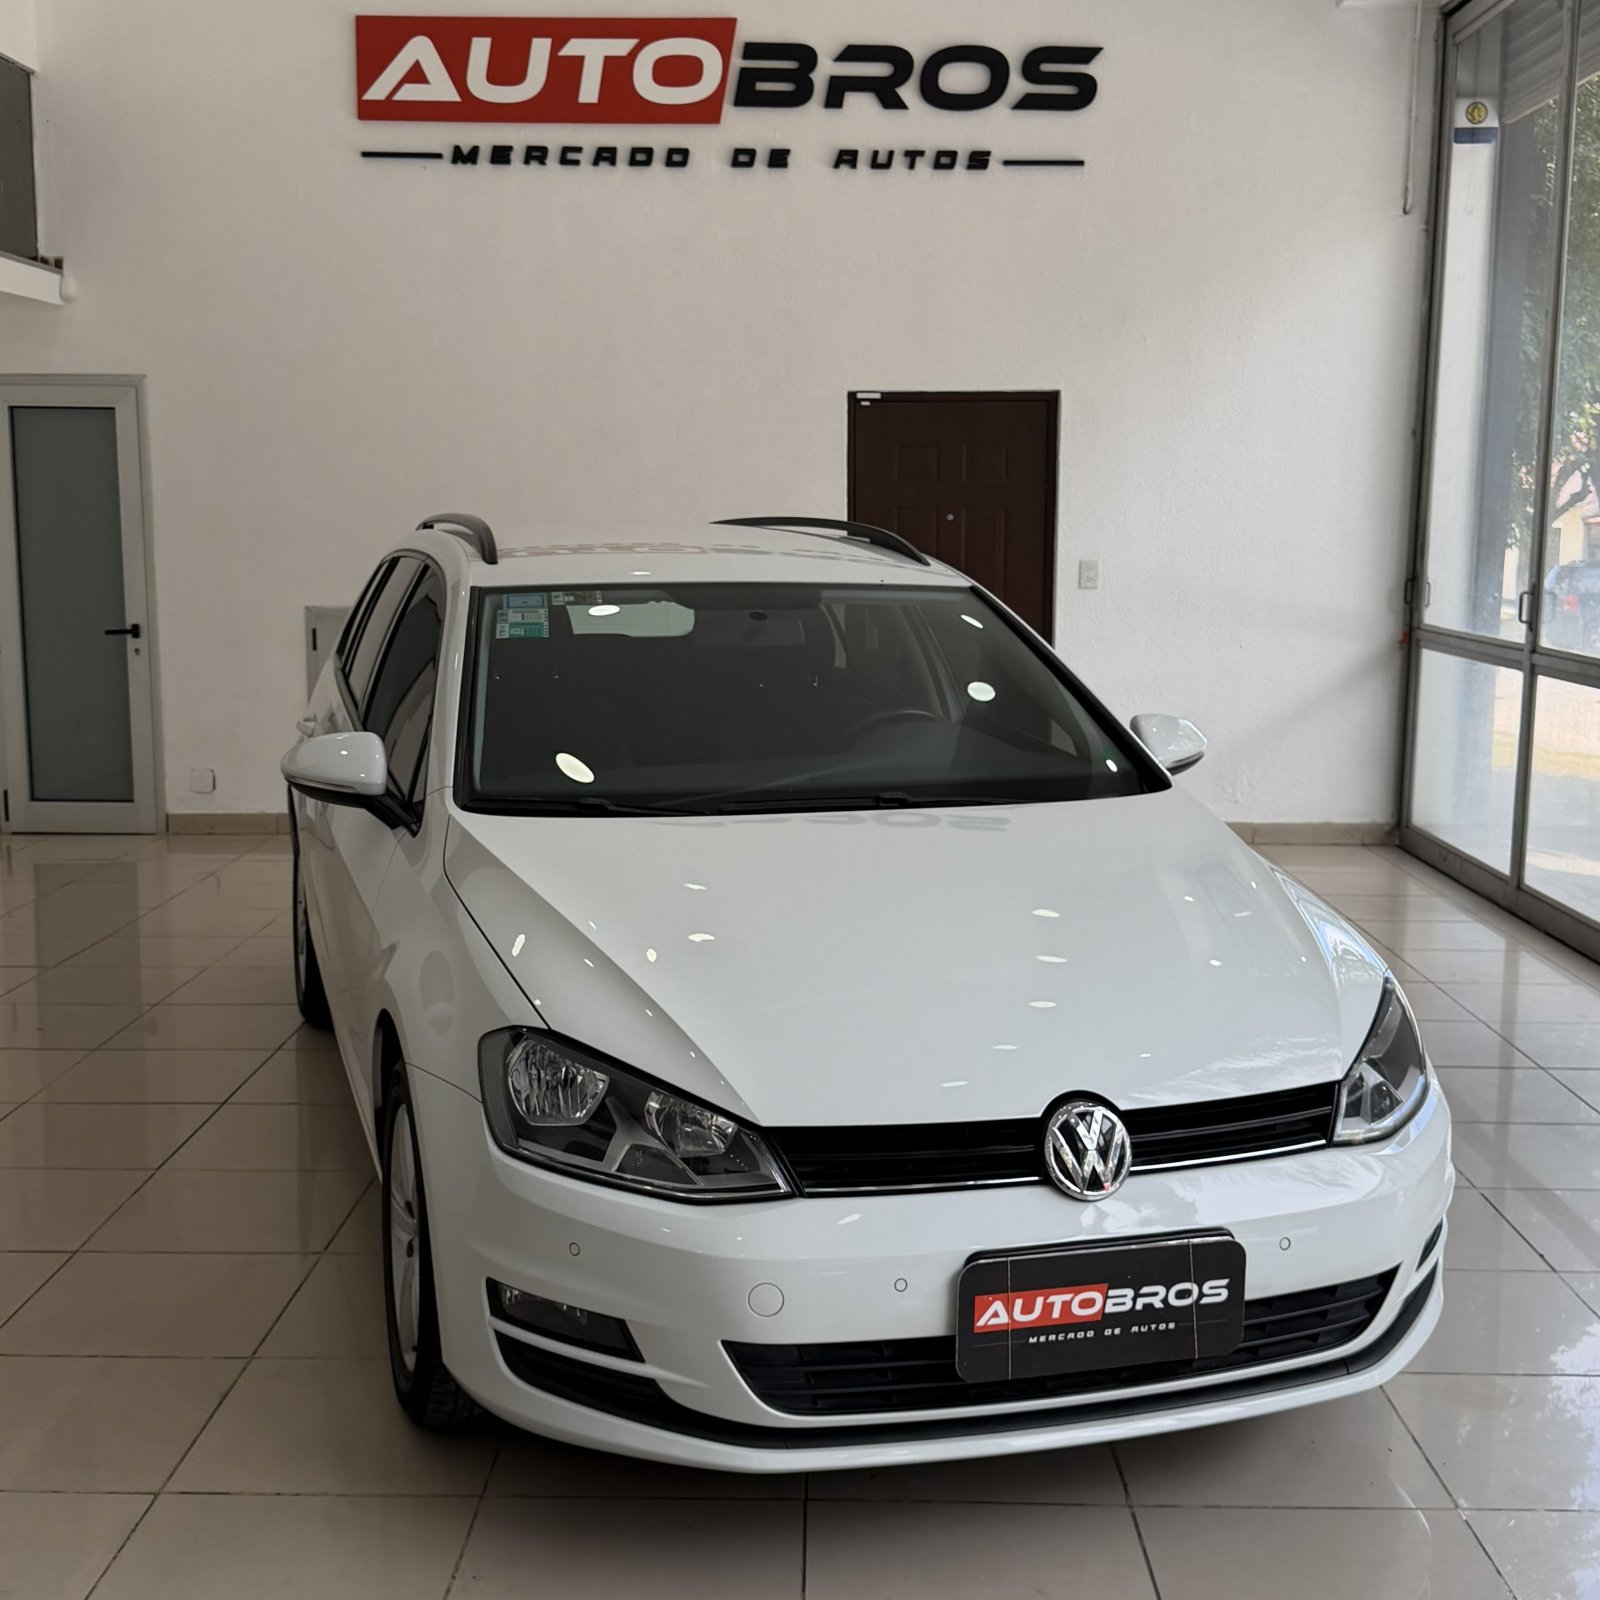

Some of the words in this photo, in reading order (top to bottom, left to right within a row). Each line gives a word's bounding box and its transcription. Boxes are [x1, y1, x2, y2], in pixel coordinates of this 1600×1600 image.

[451, 144, 690, 168] MERCADO
[731, 147, 791, 169] DE
[833, 149, 992, 170] AUTOS
[1028, 1330, 1095, 1343] MERCADO
[1104, 1326, 1121, 1336] DE
[1131, 1321, 1176, 1333] AUTOS
